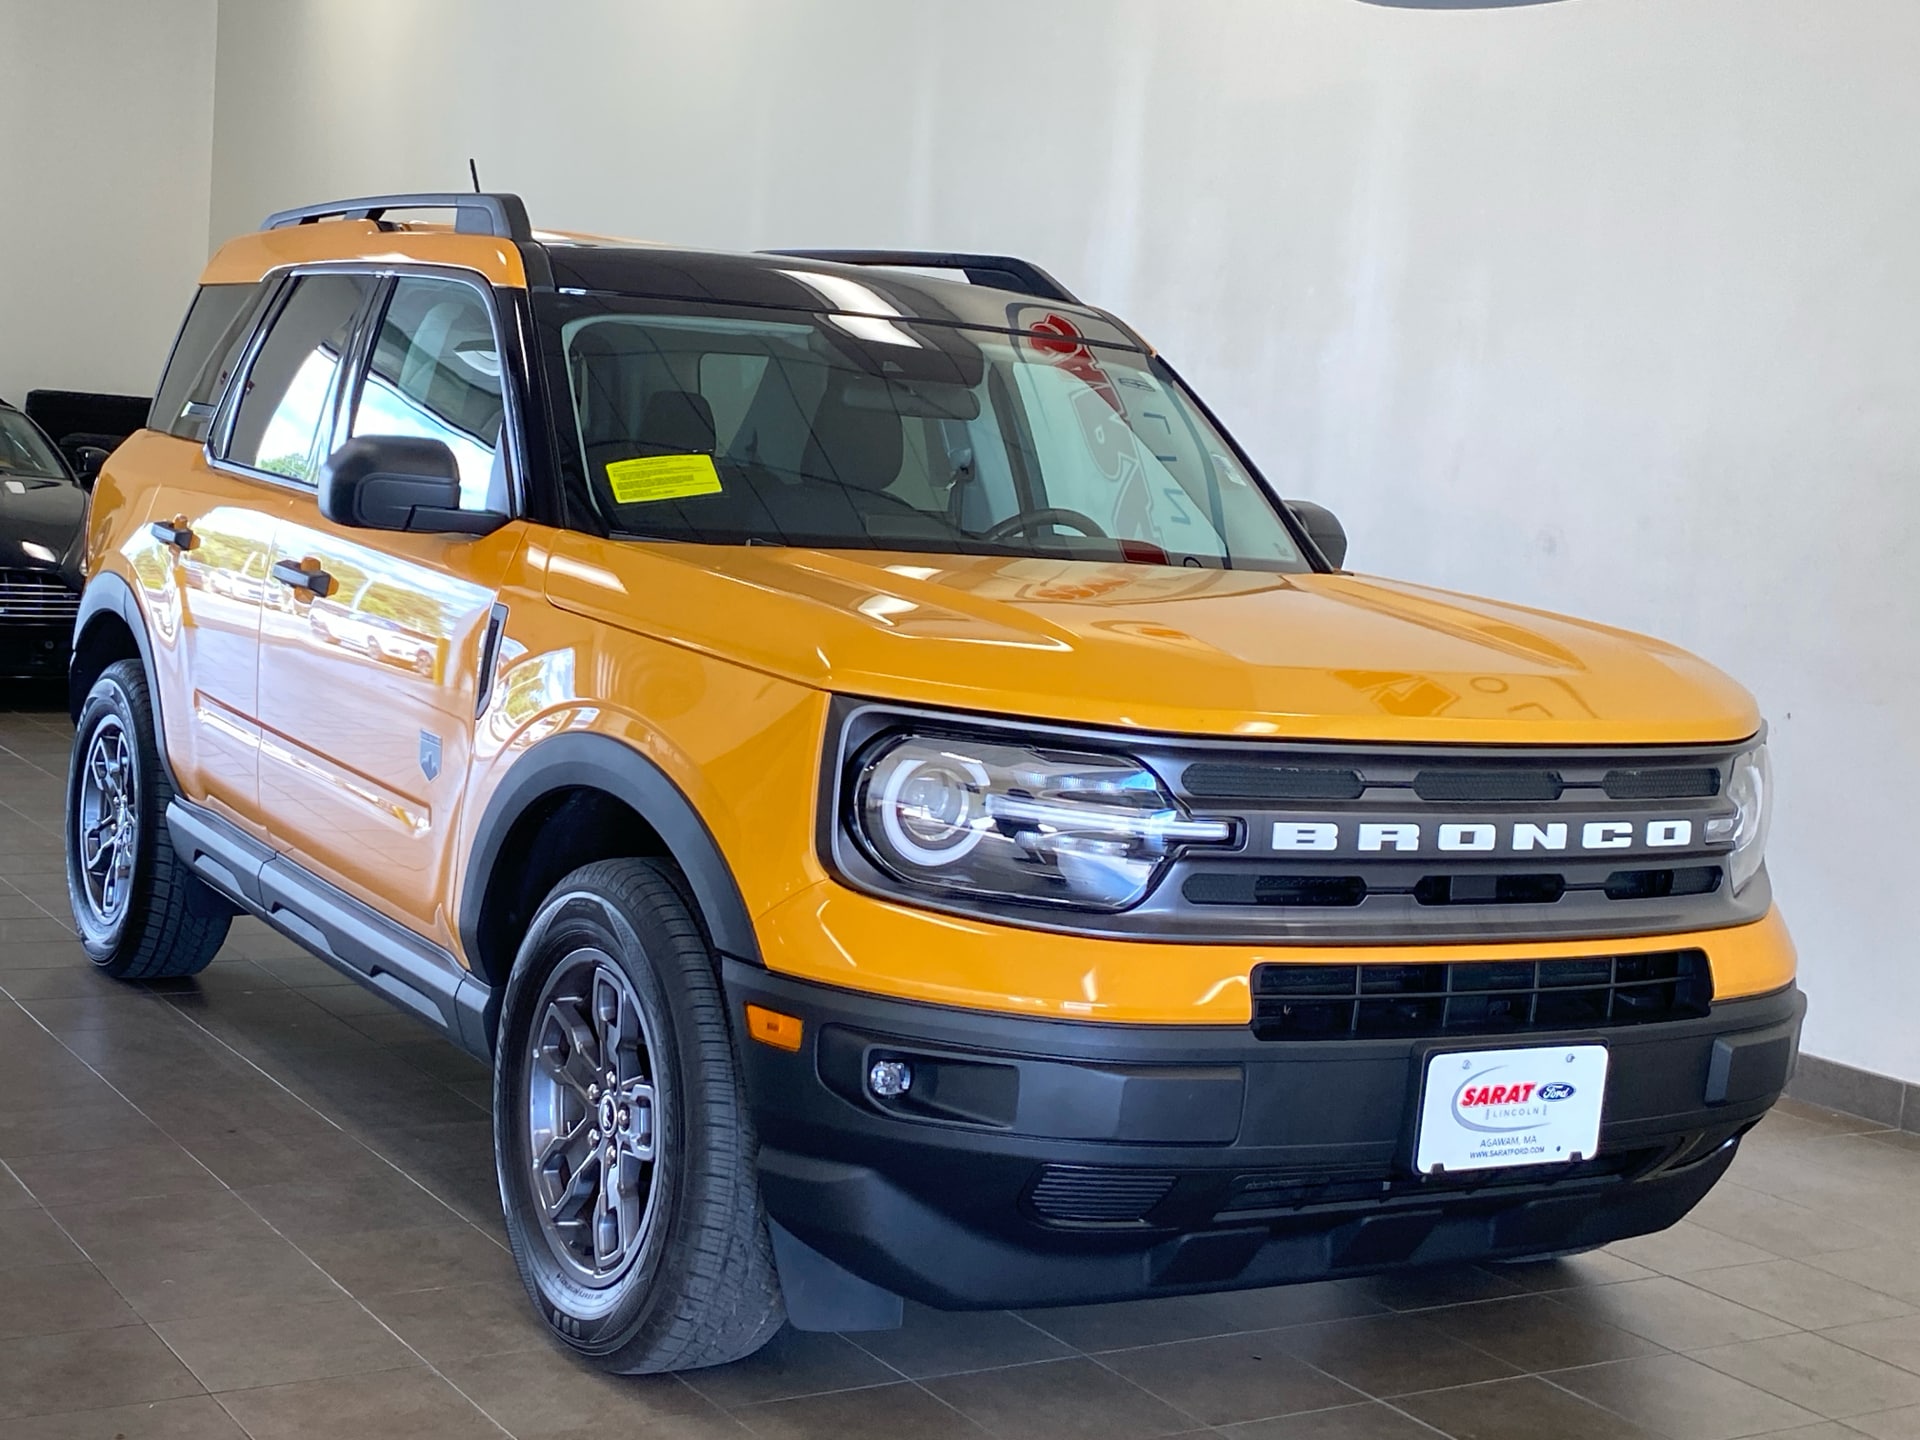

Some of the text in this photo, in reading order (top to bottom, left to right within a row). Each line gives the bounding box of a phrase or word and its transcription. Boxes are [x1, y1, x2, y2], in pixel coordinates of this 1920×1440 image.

[1272, 820, 1692, 851] BRONCO
[1460, 1082, 1571, 1108] SARAT Ford
[1492, 1109, 1540, 1118] LINCOLN
[1479, 1135, 1537, 1147] AGAWAM, MA
[1469, 1146, 1545, 1158] WWW.SARATFORD.COM
